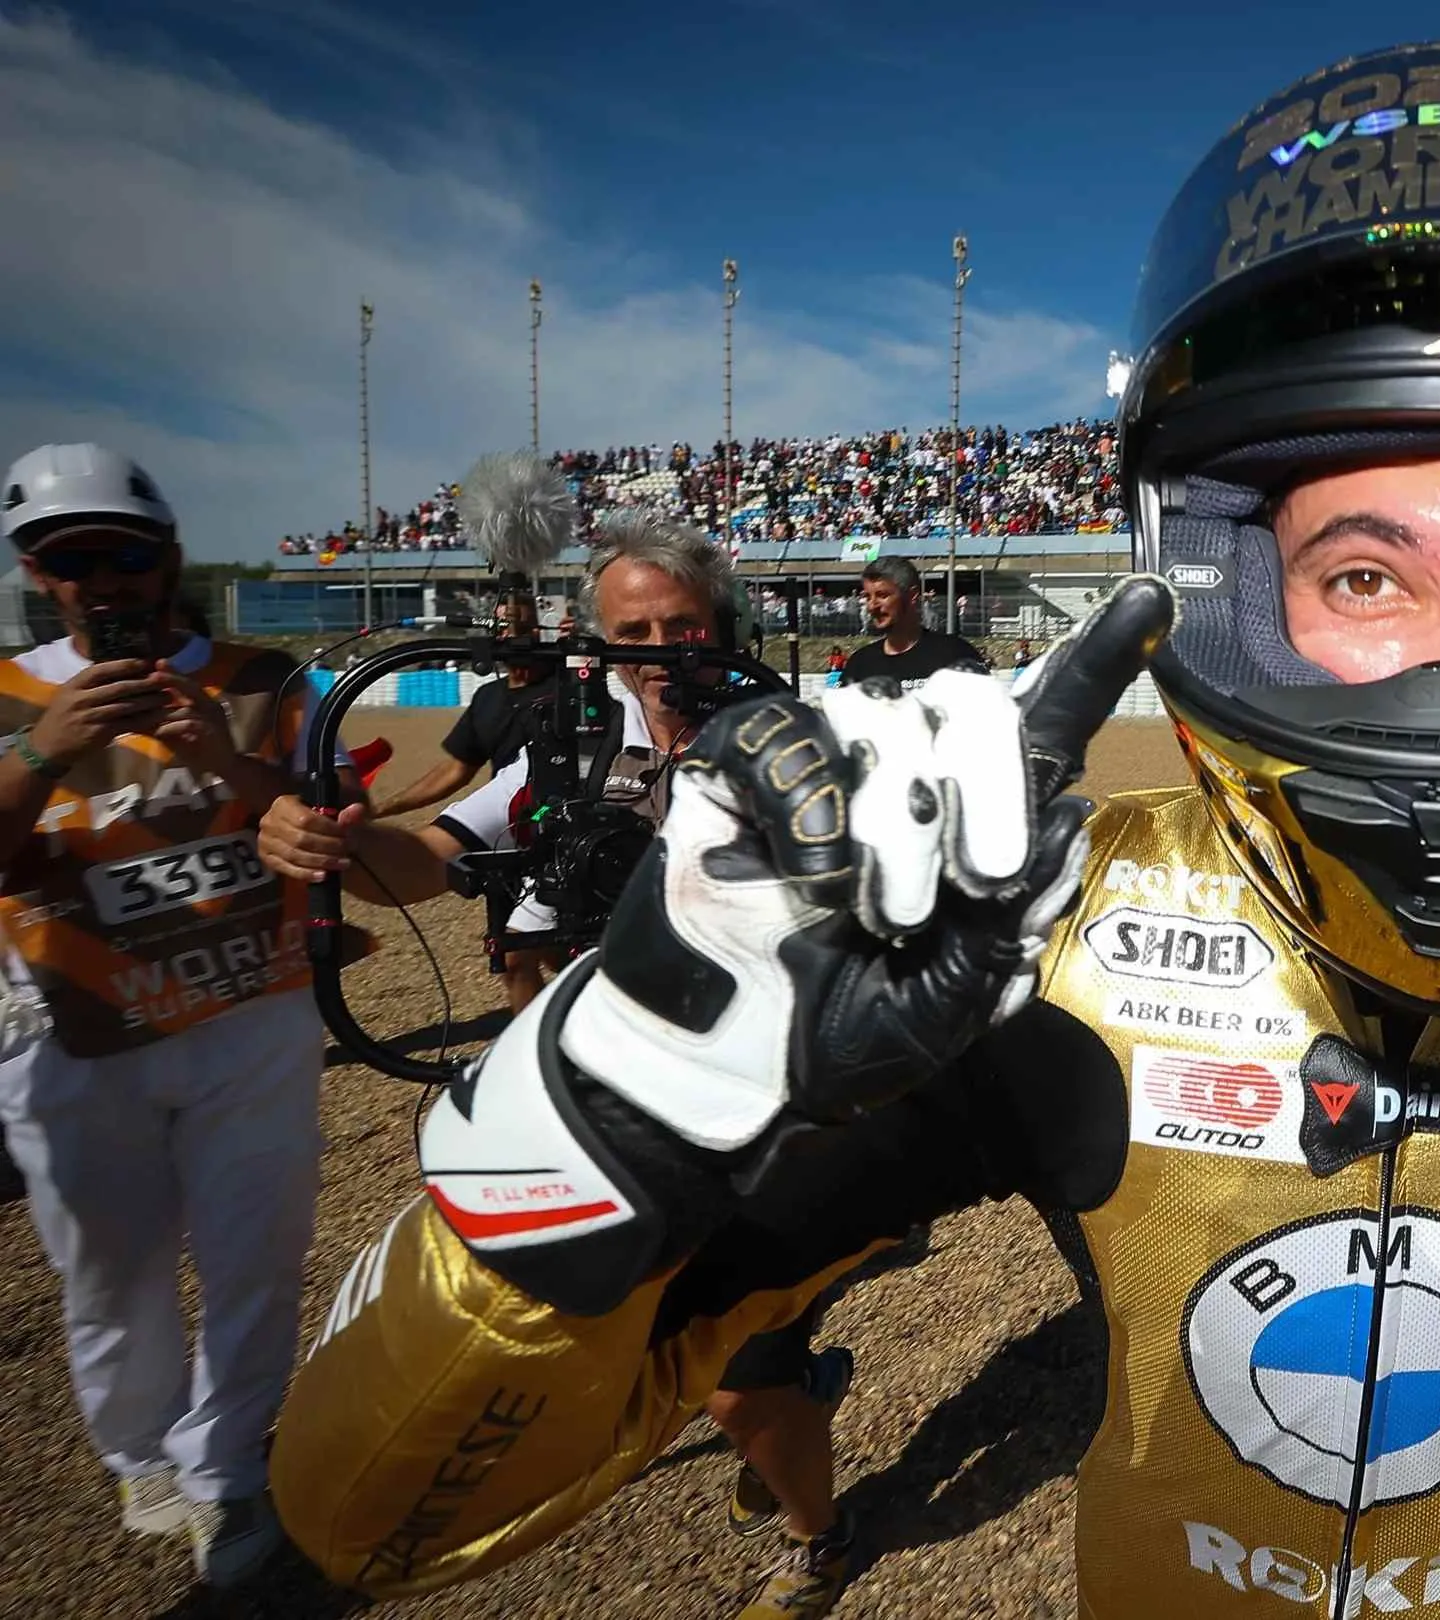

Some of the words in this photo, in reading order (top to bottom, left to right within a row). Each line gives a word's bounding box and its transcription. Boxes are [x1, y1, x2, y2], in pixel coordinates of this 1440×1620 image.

[1174, 568, 1215, 584] SHOEI
[1112, 921, 1247, 975] SHOEI
[1118, 999, 1169, 1024] ABK
[1177, 1006, 1243, 1032] BEER
[1255, 1016, 1293, 1037] 0%
[1155, 1122, 1266, 1149] OUTDO
